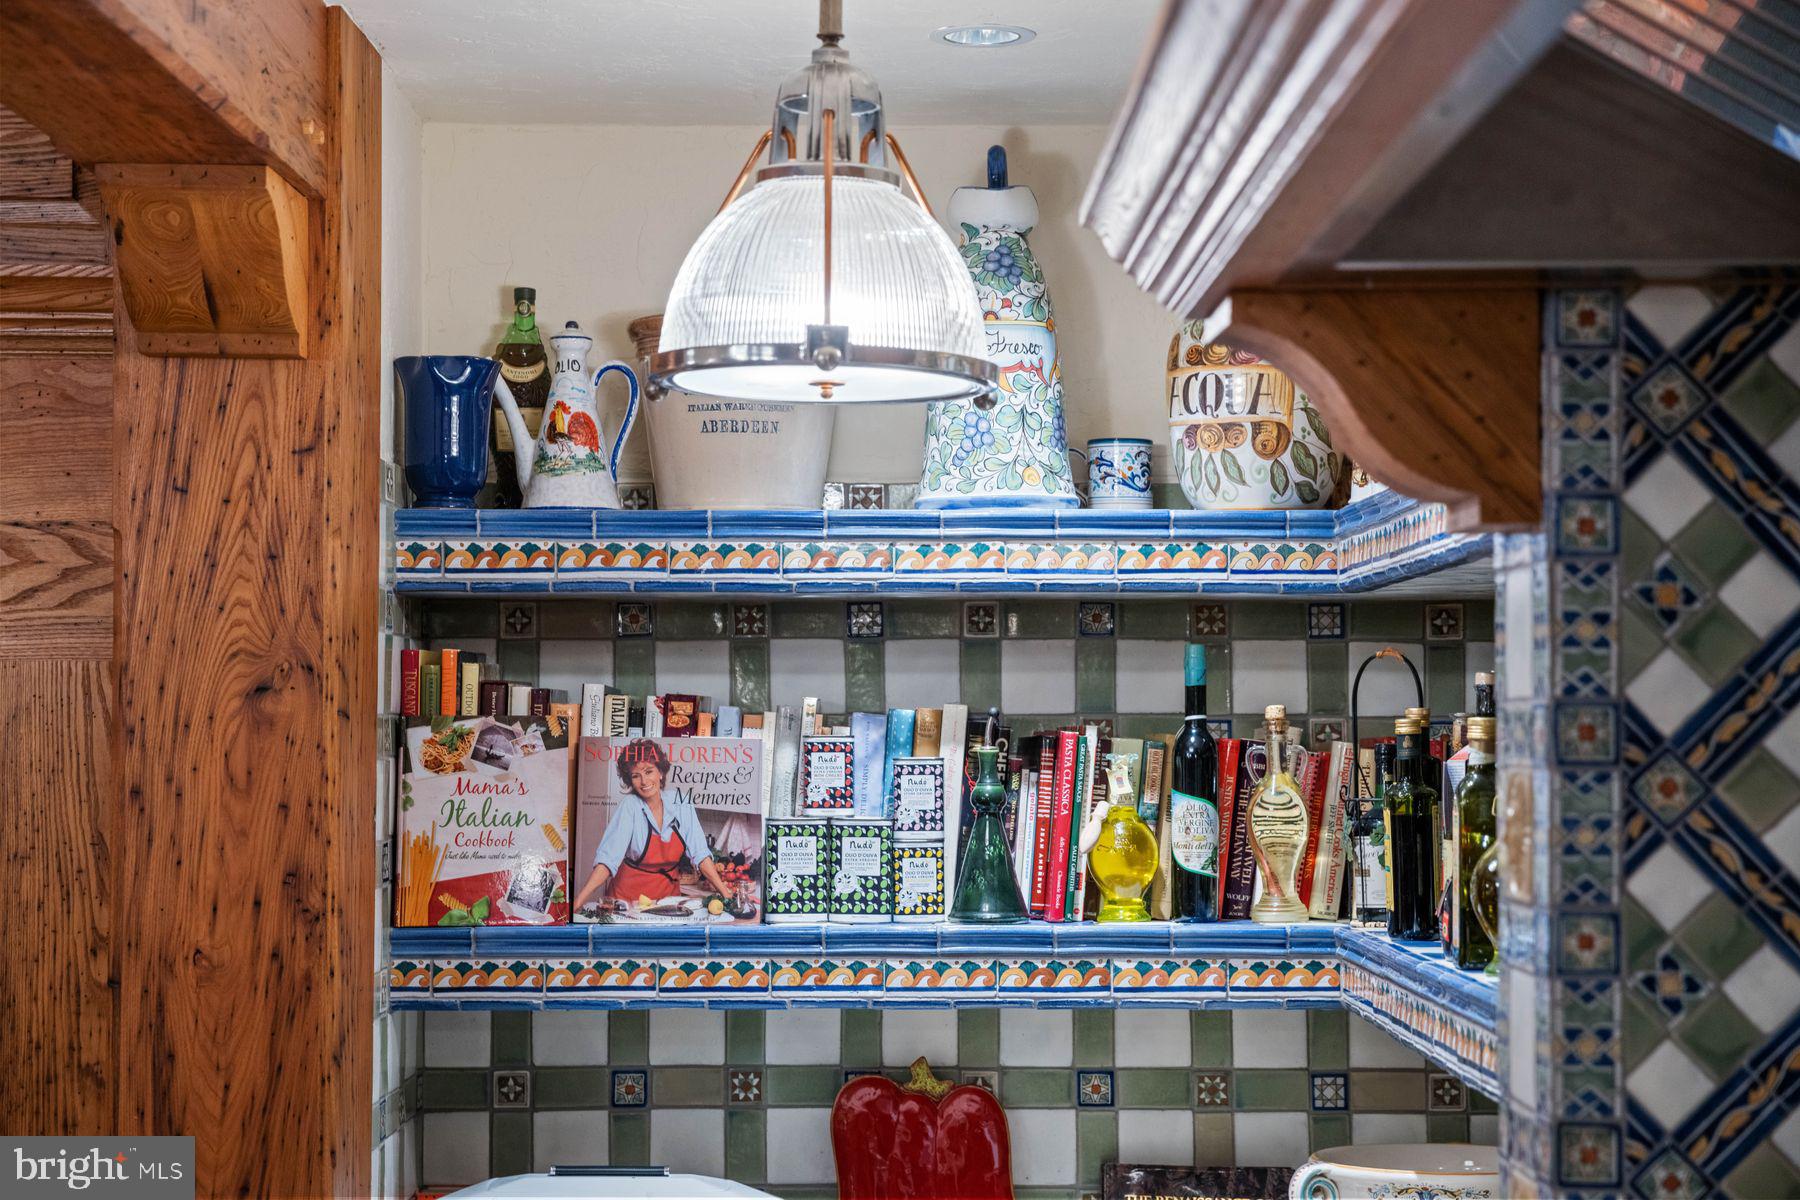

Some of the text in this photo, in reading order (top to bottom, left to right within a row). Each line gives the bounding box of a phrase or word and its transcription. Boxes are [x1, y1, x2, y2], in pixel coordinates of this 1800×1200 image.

[985, 330, 1043, 356] Fresco
[554, 359, 581, 374] OLIO
[1169, 371, 1282, 418] ACQUA
[687, 403, 722, 412] ITALIAN
[700, 419, 780, 434] ABERDEEN
[405, 669, 418, 716] TUSCANY
[610, 697, 625, 737] ITALIAN
[584, 743, 753, 763] SOPHIA LOREN'S
[817, 755, 838, 764] Nudo
[1063, 738, 1074, 768] PASTA
[671, 765, 755, 790] Recipes &
[907, 778, 927, 786] Nudo
[1077, 762, 1085, 780] PASTA
[1338, 756, 1353, 785] Frugal
[450, 777, 530, 797] Mama's
[673, 786, 751, 806] Memories
[1060, 769, 1072, 815] CLASSICA
[1076, 780, 1084, 803] SAUCES
[439, 796, 535, 828] Italian
[1182, 811, 1211, 819] EXTRA
[1186, 803, 1208, 811] OLIO
[1219, 774, 1234, 854] JUSTIN WILSON'S
[1335, 785, 1347, 827] urmet
[1179, 819, 1215, 827] VERGINE
[1233, 811, 1246, 852] ITALIAN
[1309, 811, 1320, 836] FIERY
[454, 830, 516, 849] Cookbook
[785, 840, 809, 848] Nudo
[849, 840, 873, 849] Nudo
[1332, 828, 1343, 858] Cooks
[1230, 852, 1242, 880] WAY
[1304, 837, 1316, 879] CUISINES
[1036, 852, 1045, 894] ANDREWS
[1241, 859, 1253, 887] WELL
[1326, 859, 1340, 904] American
